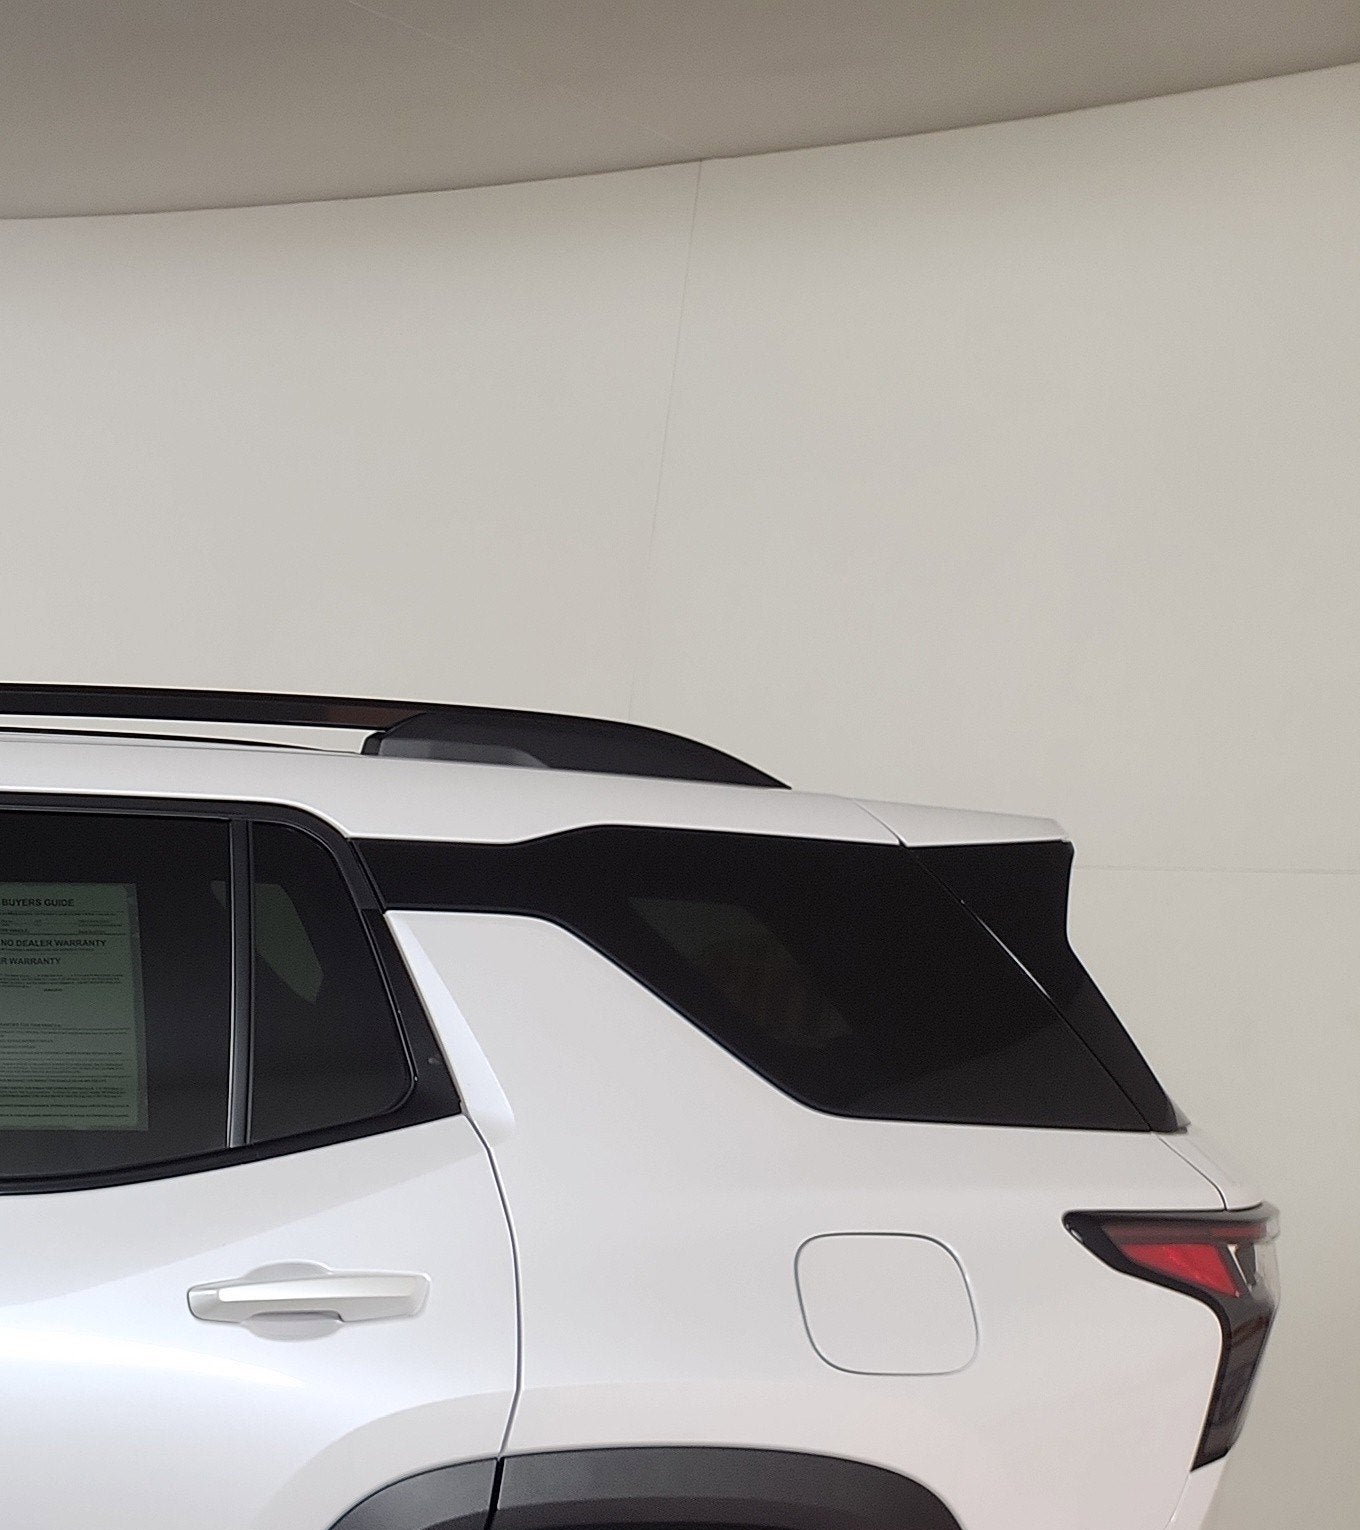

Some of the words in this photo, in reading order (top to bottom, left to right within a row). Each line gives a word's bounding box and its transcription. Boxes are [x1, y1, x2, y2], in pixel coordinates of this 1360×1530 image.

[1, 898, 42, 907] BUYERS
[44, 898, 75, 907] GUIDE
[16, 939, 53, 947] DEALER
[9, 957, 61, 965] WARRANTY
